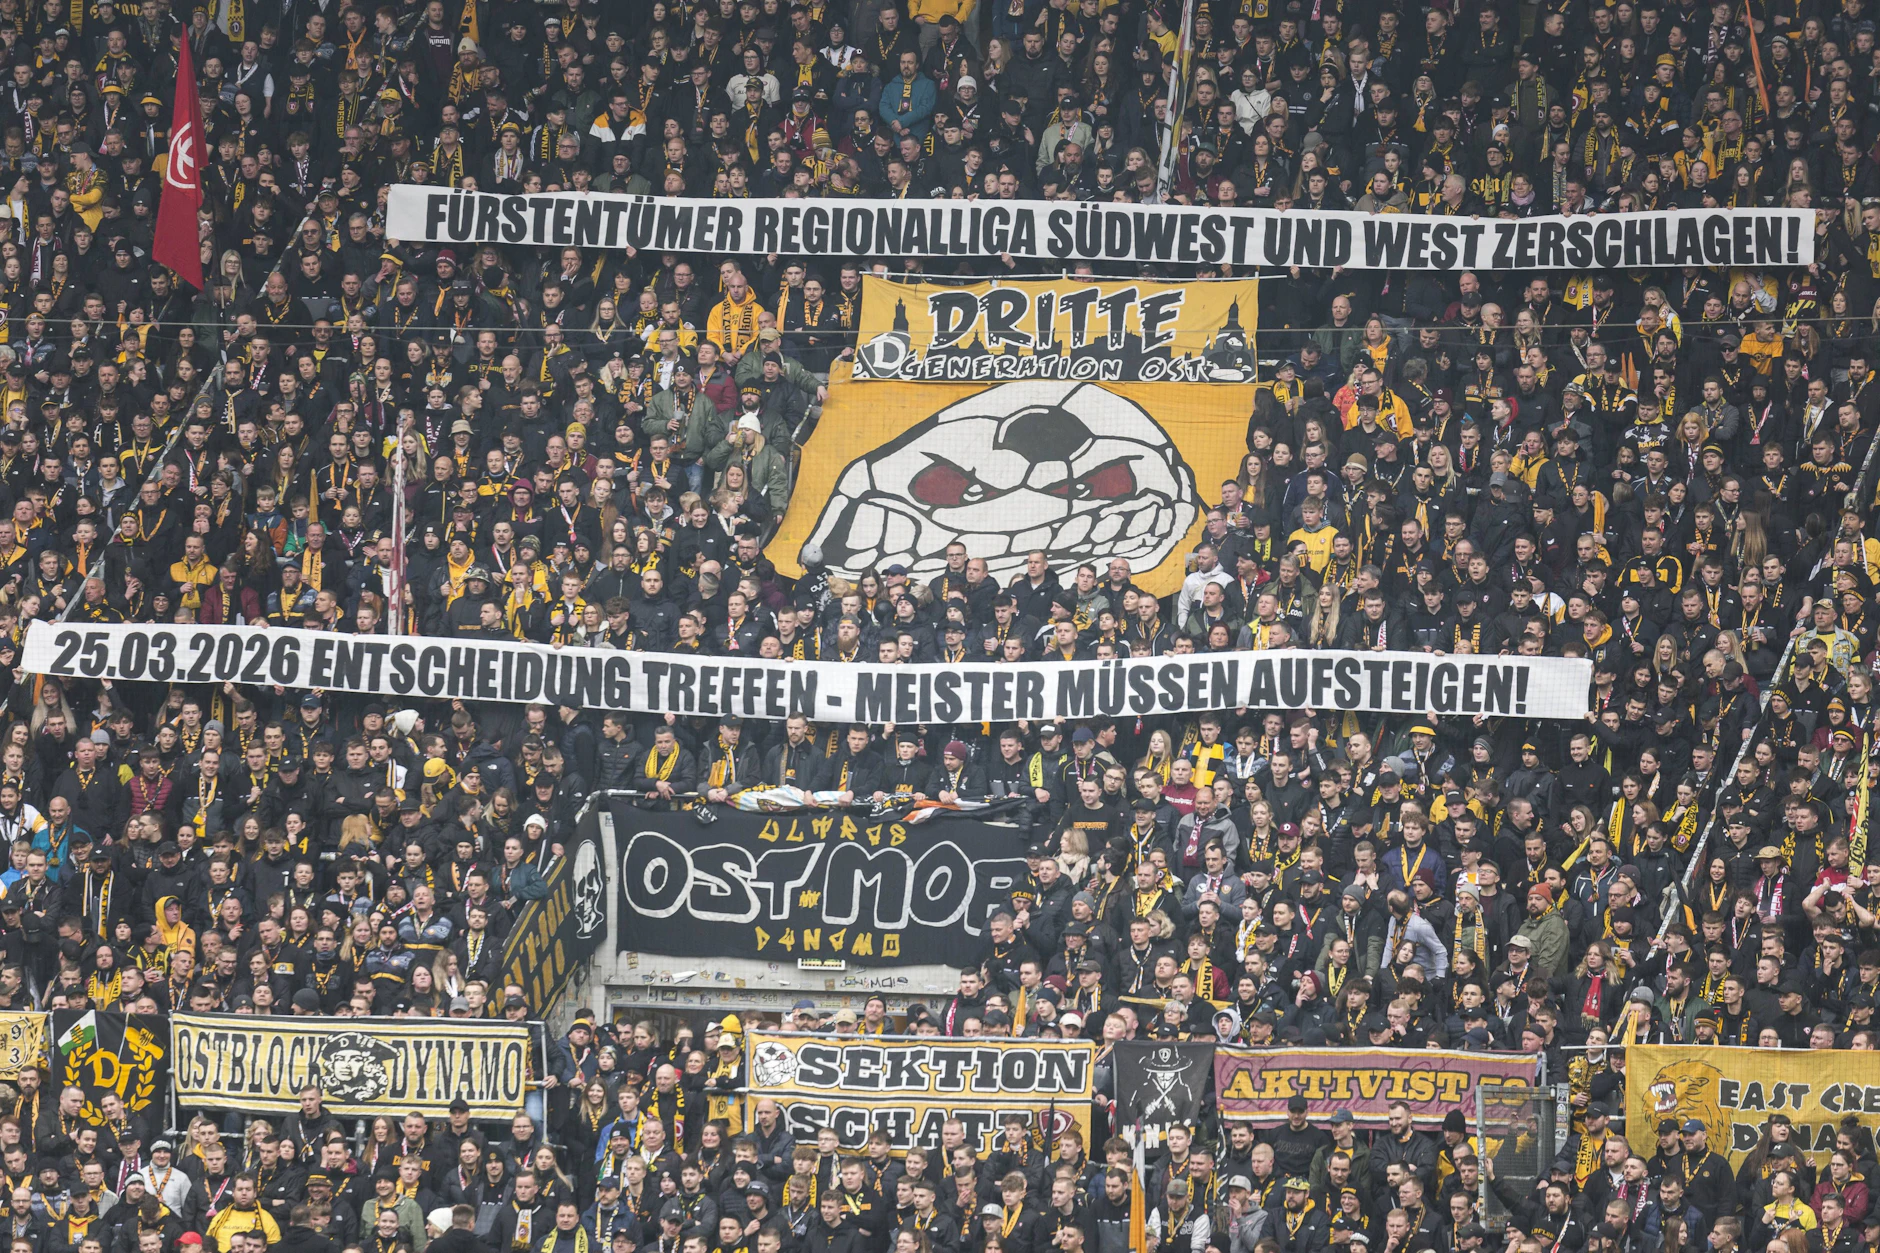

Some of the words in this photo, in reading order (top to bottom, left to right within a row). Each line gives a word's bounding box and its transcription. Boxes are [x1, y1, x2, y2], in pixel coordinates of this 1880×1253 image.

[427, 190, 743, 252] FÜRSTENTÜMER
[753, 206, 1037, 256] REGIONALLIGA
[1047, 203, 1254, 264] SÜDWEST
[1263, 217, 1352, 266] UND
[1363, 220, 1485, 269] WEST
[1491, 214, 1801, 268] ZERSCHLAGEN!
[928, 286, 1186, 353] DRITTE
[900, 349, 1123, 381] GENERATION
[1138, 355, 1208, 381] OST
[50, 630, 301, 685] 25.03.2026
[309, 637, 632, 709] ENTSCHEIDUNG
[642, 660, 818, 719] TREFFEN
[855, 671, 1045, 723] MEISTER
[1056, 659, 1239, 717] MÜSSEN
[1248, 657, 1530, 714] AUFSTEIGEN!
[178, 1029, 327, 1096] OSTBLOCK
[388, 1039, 523, 1103] DYNAMO
[795, 1043, 1091, 1094] SEKTION
[1222, 1067, 1469, 1102] AKTIVIST
[1718, 1078, 1811, 1112] EAST
